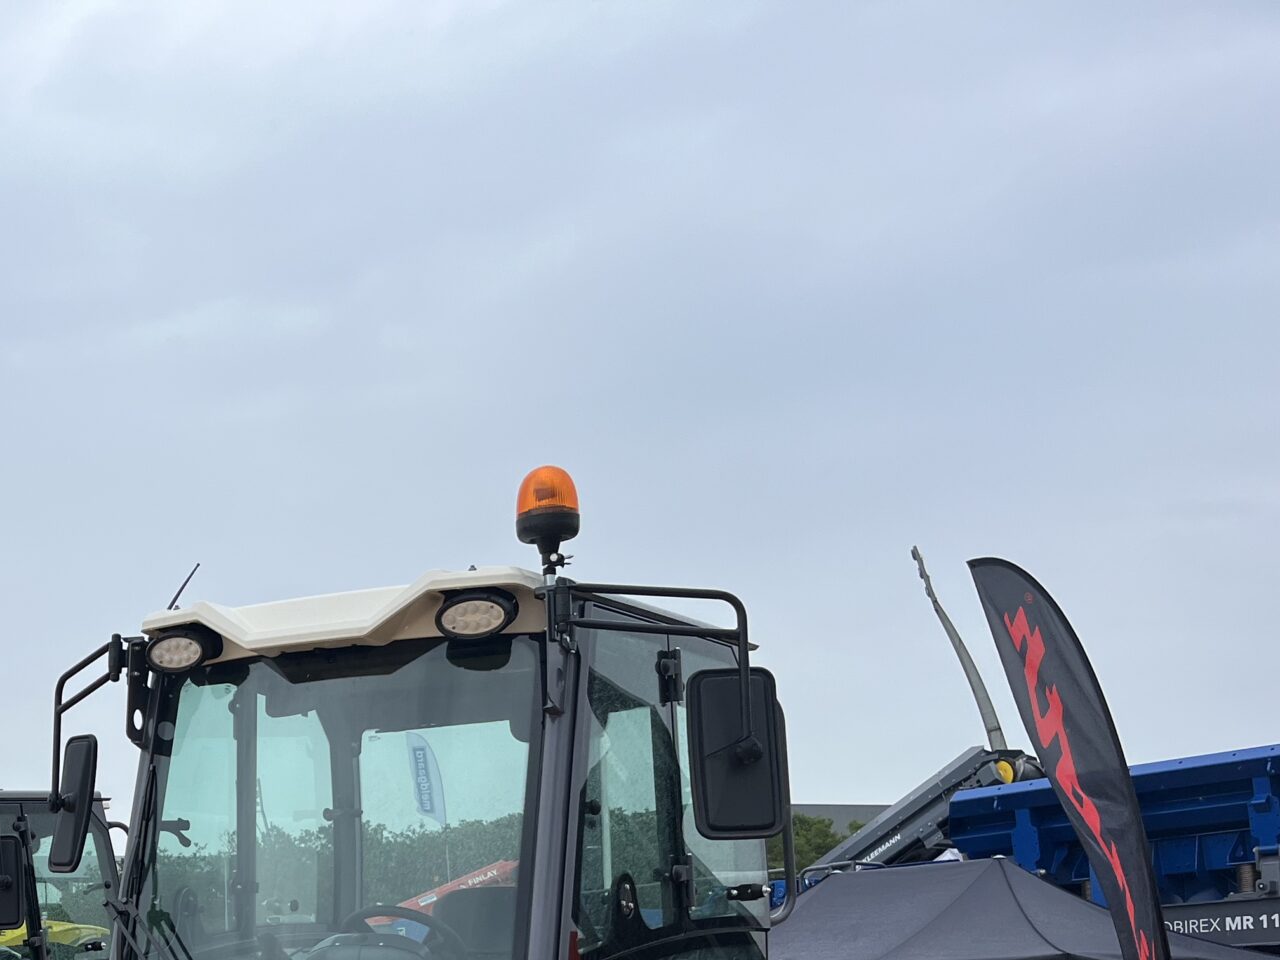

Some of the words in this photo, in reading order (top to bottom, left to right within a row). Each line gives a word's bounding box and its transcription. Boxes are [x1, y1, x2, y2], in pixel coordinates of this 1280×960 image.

[467, 868, 498, 887] FINLAY
[1164, 917, 1221, 934] BIREX
[1225, 915, 1254, 931] MR
